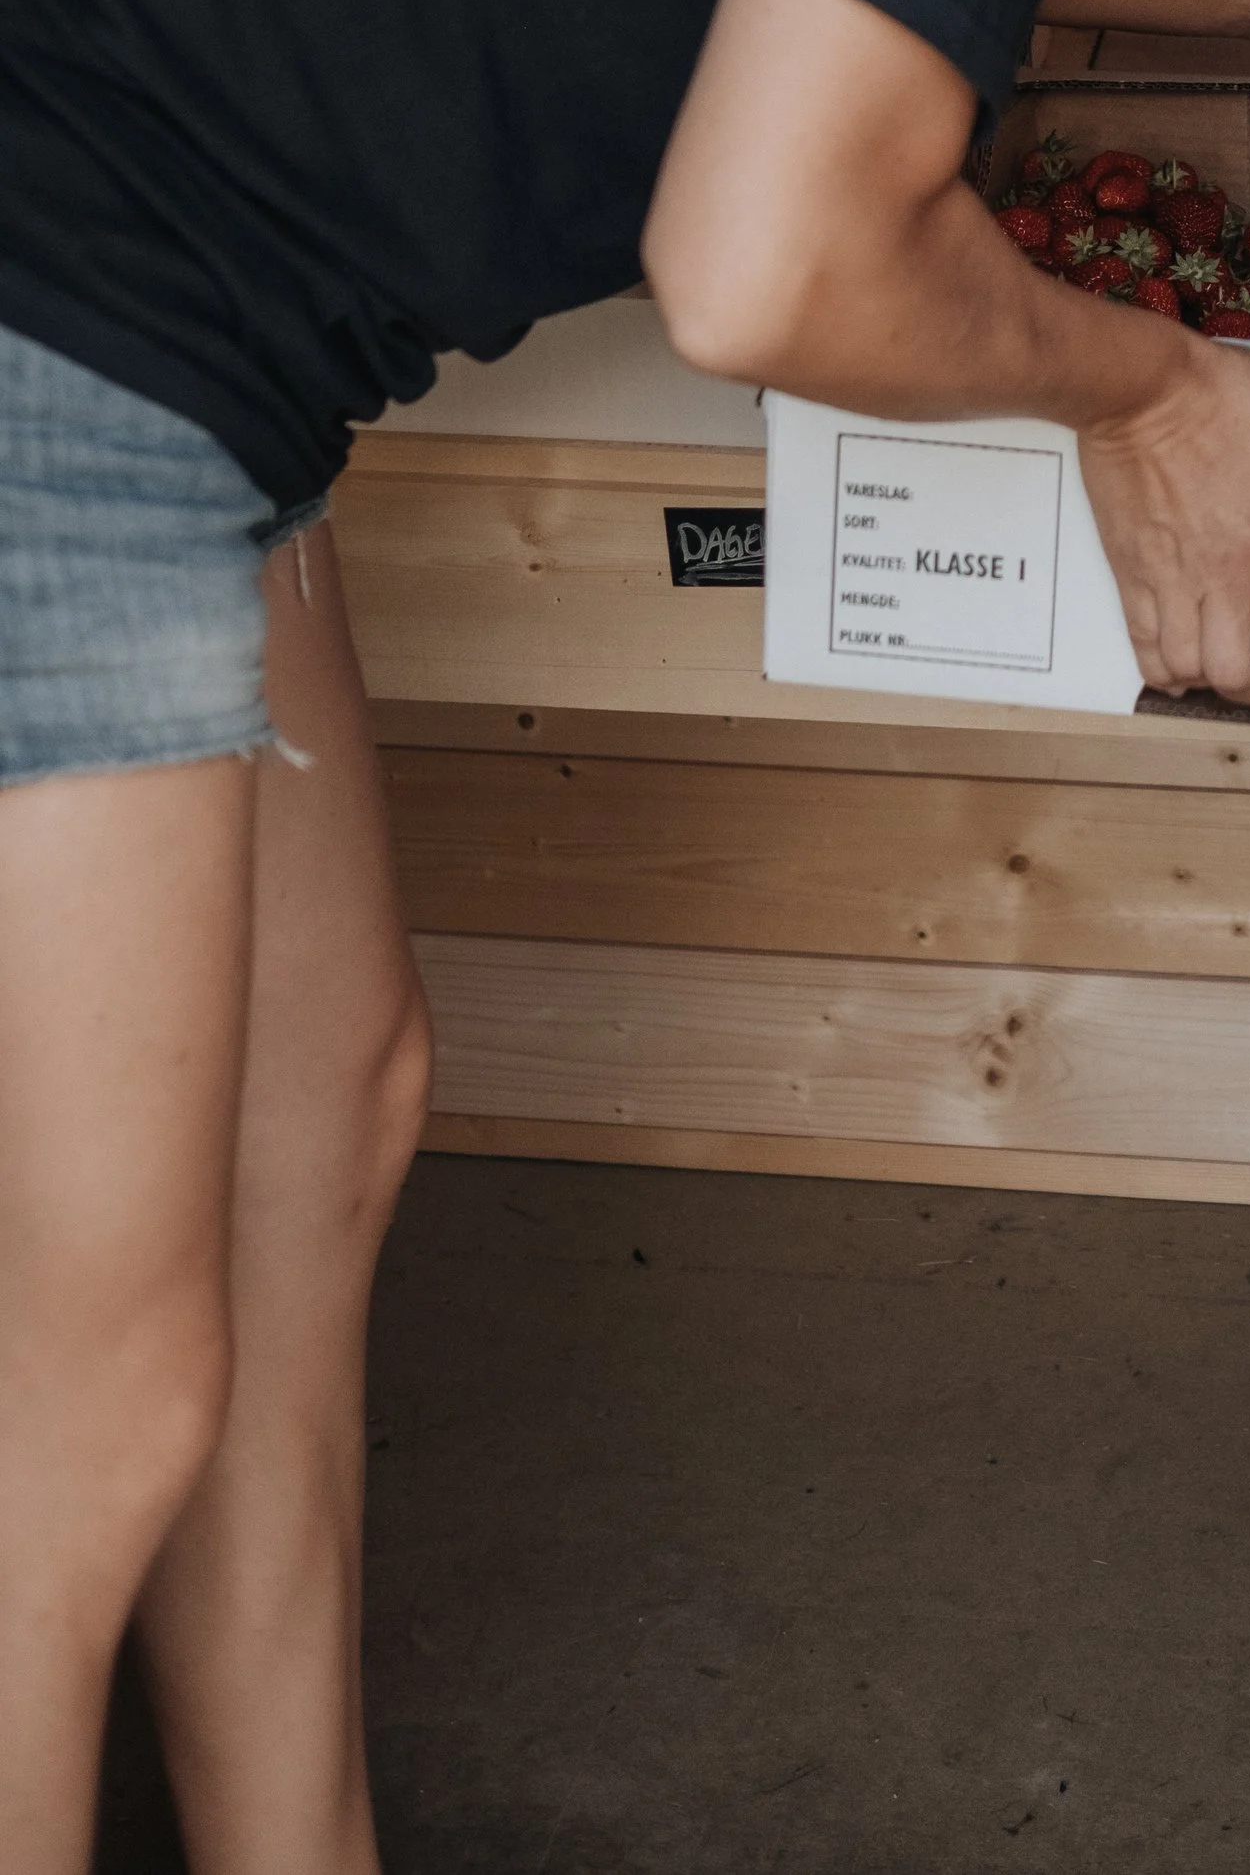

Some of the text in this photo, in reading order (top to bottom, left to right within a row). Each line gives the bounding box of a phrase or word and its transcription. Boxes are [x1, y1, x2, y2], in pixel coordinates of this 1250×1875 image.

[845, 483, 913, 500] VARESLAG:
[677, 522, 765, 563] DAGE
[915, 549, 1004, 580] KLASSE
